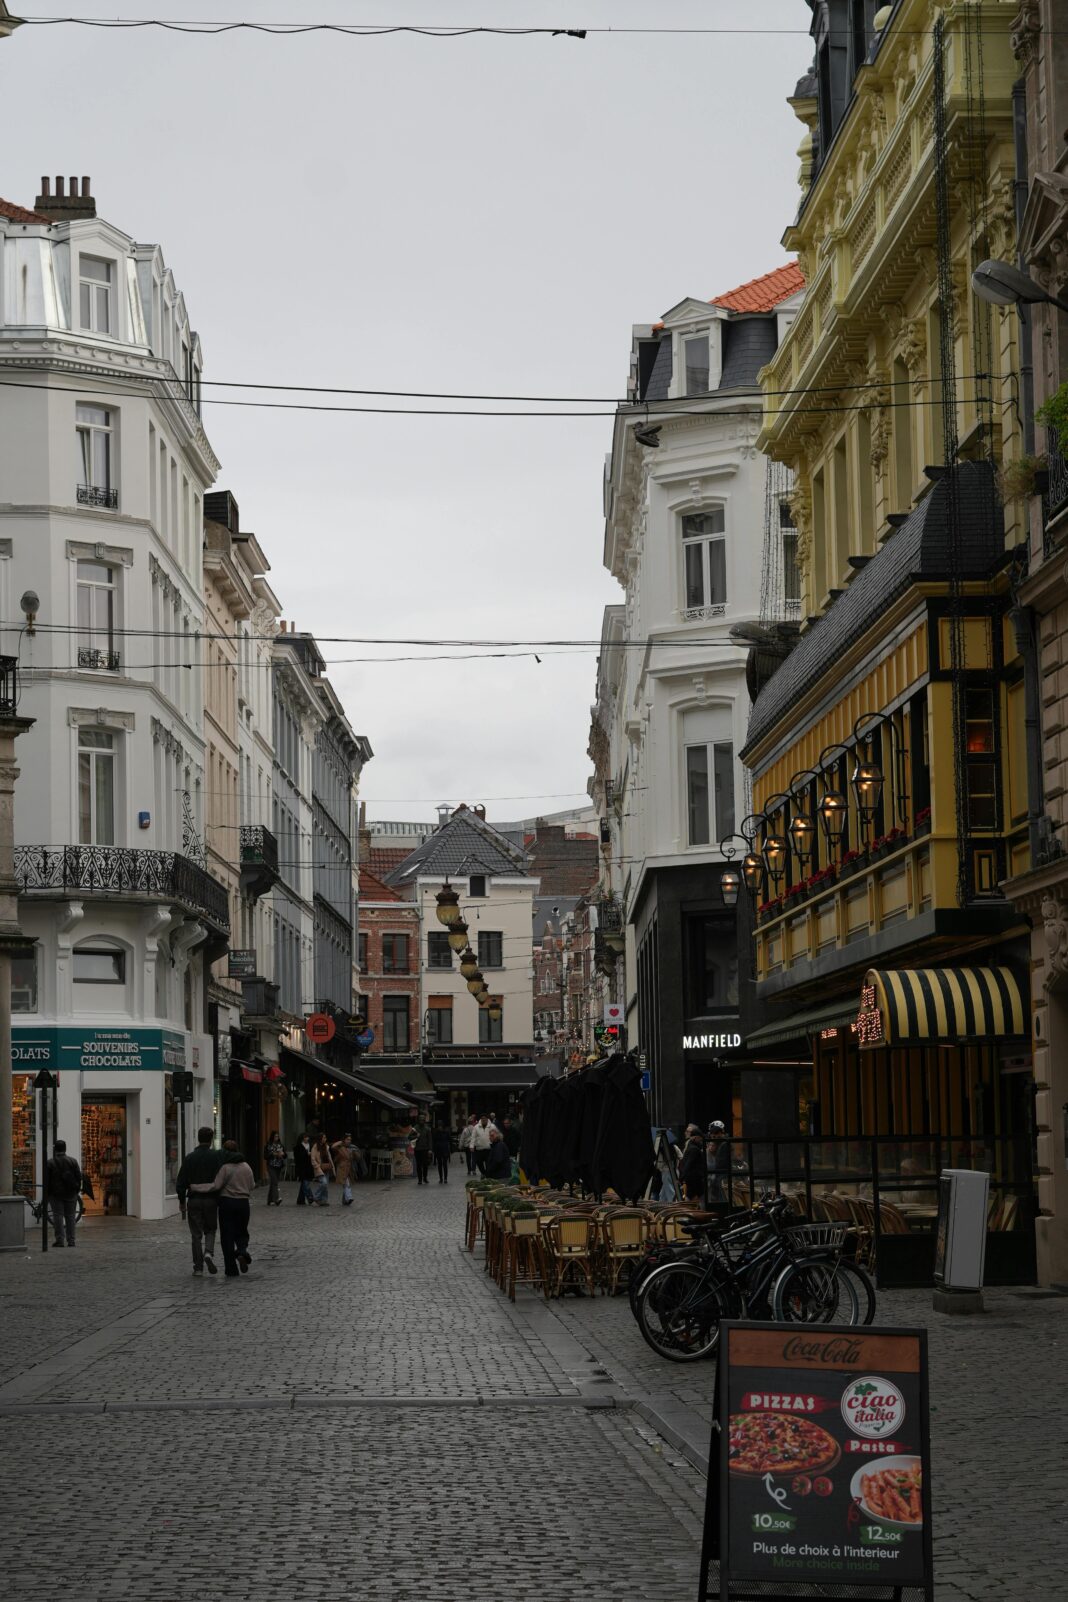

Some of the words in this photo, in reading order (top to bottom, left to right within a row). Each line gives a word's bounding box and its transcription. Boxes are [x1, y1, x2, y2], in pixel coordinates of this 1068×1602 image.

[83, 1042, 139, 1053] SOUVENIRS
[683, 1033, 741, 1049] MANFIELD
[80, 1055, 142, 1067] CHOCOLATS
[783, 1336, 864, 1364] Coca-Cola
[750, 1394, 815, 1411] PIZZAS
[847, 1391, 897, 1409] ciao
[854, 1407, 897, 1422] italia
[850, 1439, 896, 1453] Pasta
[752, 1541, 778, 1555] Plus
[780, 1542, 797, 1556] de
[799, 1543, 830, 1557] choix
[832, 1544, 841, 1557] à
[844, 1545, 900, 1559] l'interieur
[773, 1556, 804, 1568] More
[806, 1557, 843, 1569] choice
[847, 1559, 880, 1572] inside
